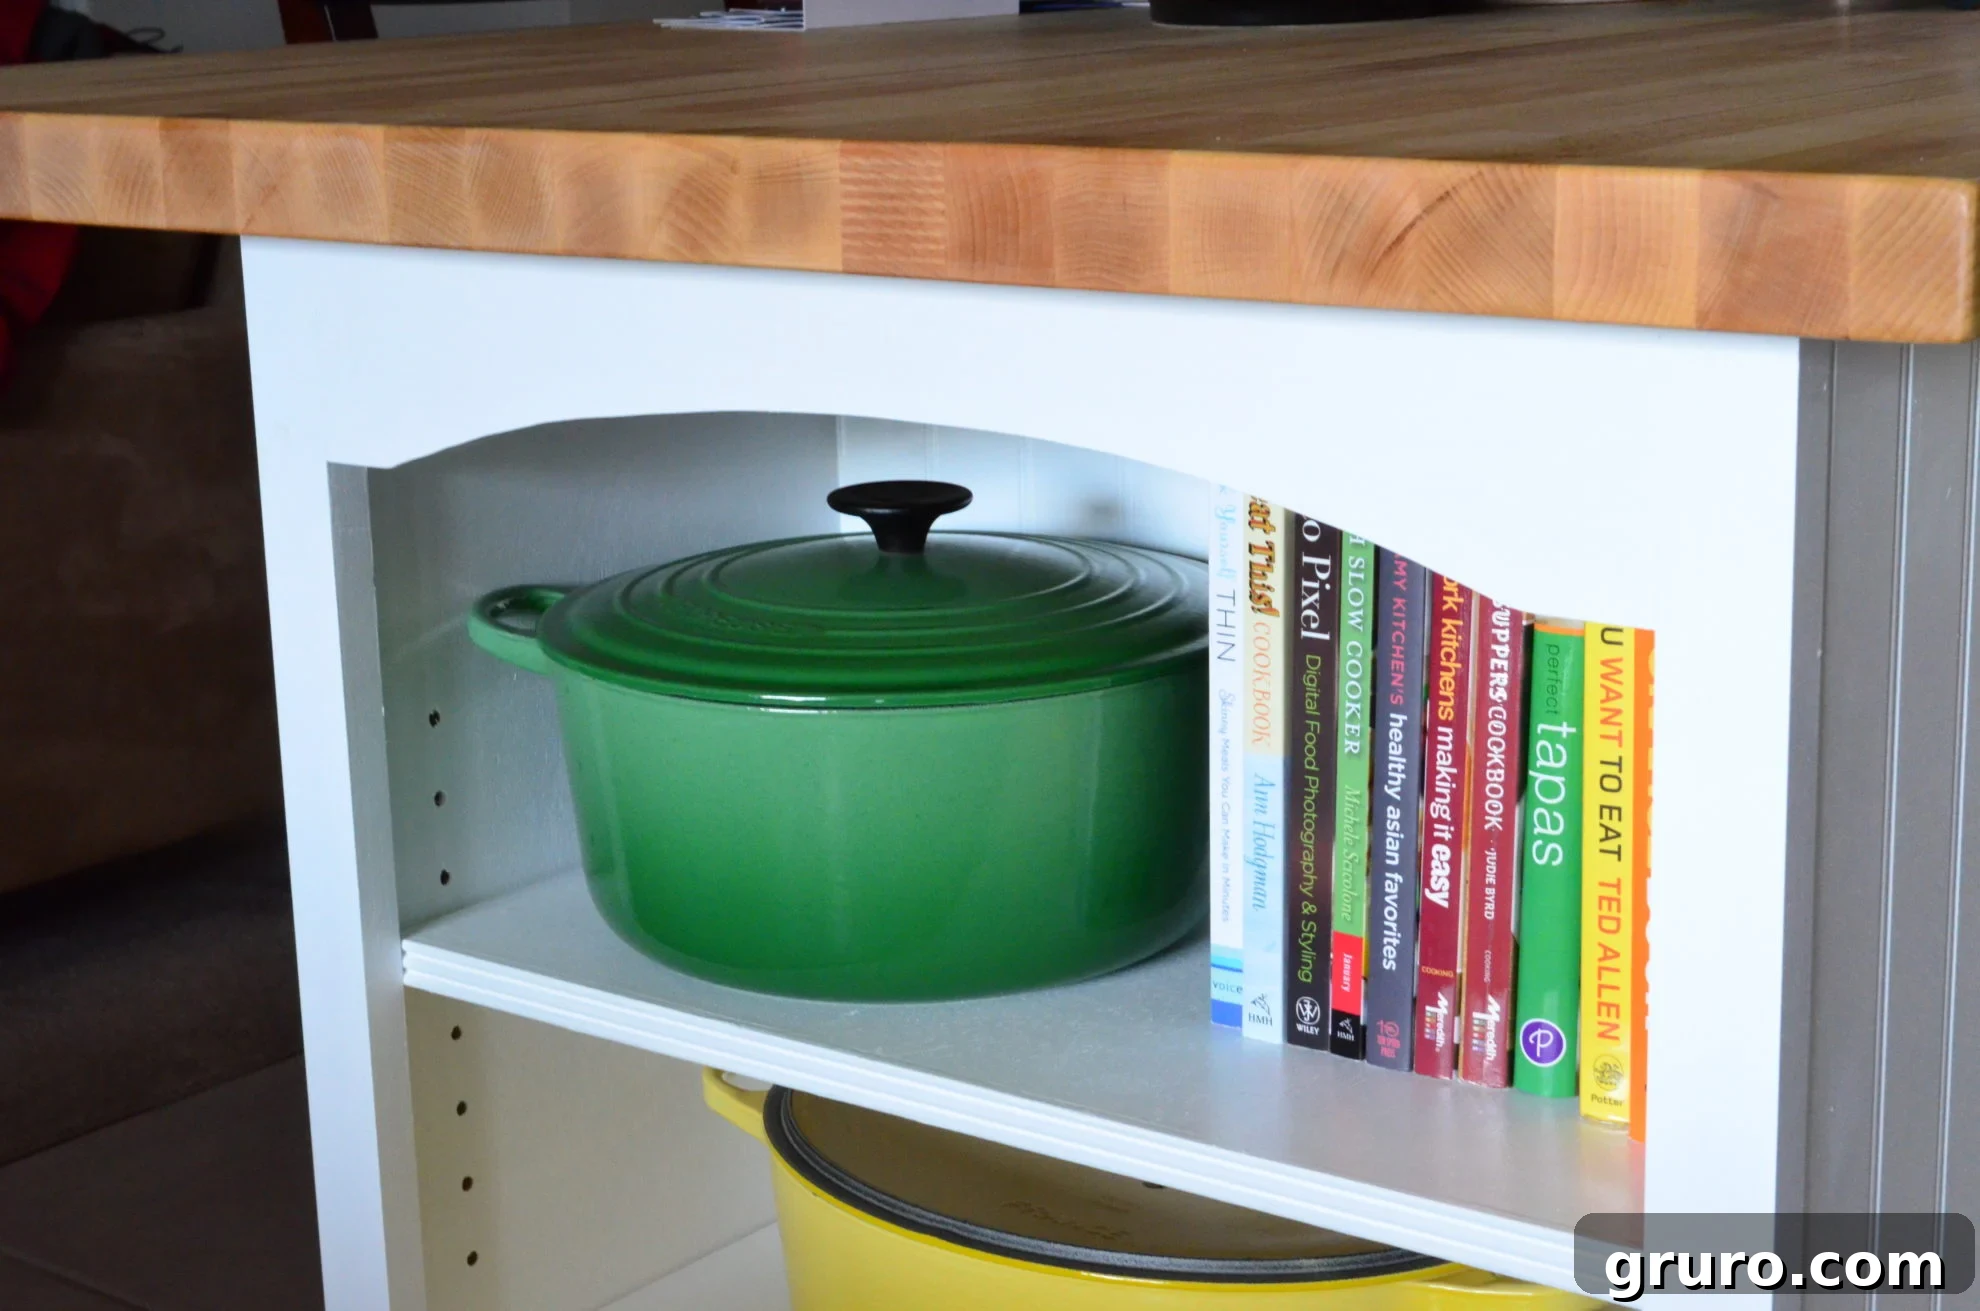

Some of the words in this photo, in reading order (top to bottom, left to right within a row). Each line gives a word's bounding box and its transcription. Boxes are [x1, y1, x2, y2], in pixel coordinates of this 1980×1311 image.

[1248, 540, 1280, 618] This!
[1300, 552, 1331, 641] Pixel
[1347, 556, 1365, 632] SLOW
[1216, 589, 1236, 661] THIN
[1390, 598, 1407, 705] KITCHEN'S
[1252, 622, 1271, 745] COOKBOOK
[1302, 654, 1321, 715] Digital
[1344, 641, 1363, 754] COOKER
[1437, 618, 1463, 721] kitchens
[1545, 643, 1563, 714] perfect
[1218, 689, 1236, 734] Skinny
[1600, 657, 1623, 747] WANT
[1221, 738, 1231, 772] Meals
[1304, 719, 1320, 771] Food
[1384, 713, 1407, 800] healthy
[1430, 726, 1457, 820] making
[1484, 705, 1507, 831] COOKBOOK
[1600, 756, 1623, 793] TO
[1221, 776, 1231, 798] You
[1221, 802, 1231, 825] Can
[1254, 773, 1276, 815] Ann
[1343, 785, 1361, 846] Michele
[1529, 721, 1576, 866] tapas
[1221, 829, 1231, 860] Make
[1299, 775, 1319, 898] Photography
[1386, 806, 1404, 865] asian
[1433, 823, 1454, 840] it
[1599, 805, 1622, 862] EAT
[1244, 819, 1275, 911] Hodgman
[1341, 848, 1359, 922] Scicolone
[1425, 843, 1451, 909] easy
[1485, 849, 1496, 884] JUDIE
[1221, 876, 1230, 923] Minutes
[1301, 901, 1317, 914] &
[1382, 872, 1403, 971] favorites
[1483, 887, 1496, 920] BYRD
[1598, 877, 1621, 934] TED
[1297, 920, 1317, 984] Styling
[1422, 966, 1454, 979] COOKING
[1212, 980, 1243, 995] voice
[1596, 942, 1621, 1041] ALLEN
[1248, 1012, 1273, 1026] HMH
[1295, 1023, 1320, 1035] WILEY
[1425, 991, 1449, 1051] Meredith
[1472, 994, 1500, 1061] Meredith
[1591, 1094, 1624, 1107] Potter
